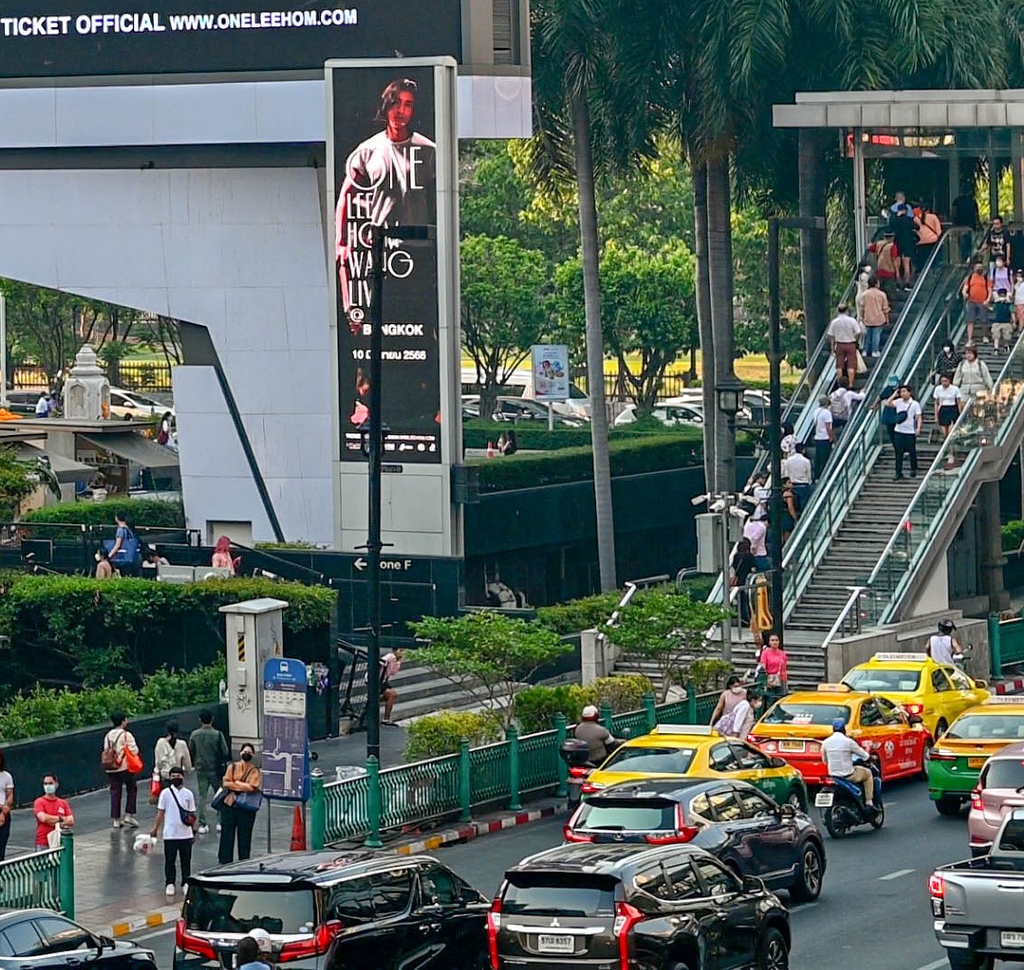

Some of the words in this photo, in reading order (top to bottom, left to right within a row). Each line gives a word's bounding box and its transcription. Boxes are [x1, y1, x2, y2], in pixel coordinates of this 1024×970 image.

[0, 16, 72, 37] TICKET
[75, 12, 166, 34] OFFICIAL
[169, 8, 358, 31] WWW.ONELEEHOM.COM
[346, 146, 424, 198] ONE
[347, 192, 375, 220] LEE
[348, 280, 373, 308] LIV
[349, 308, 364, 323] @
[362, 323, 424, 336] BNGKOK
[352, 349, 365, 360] 10
